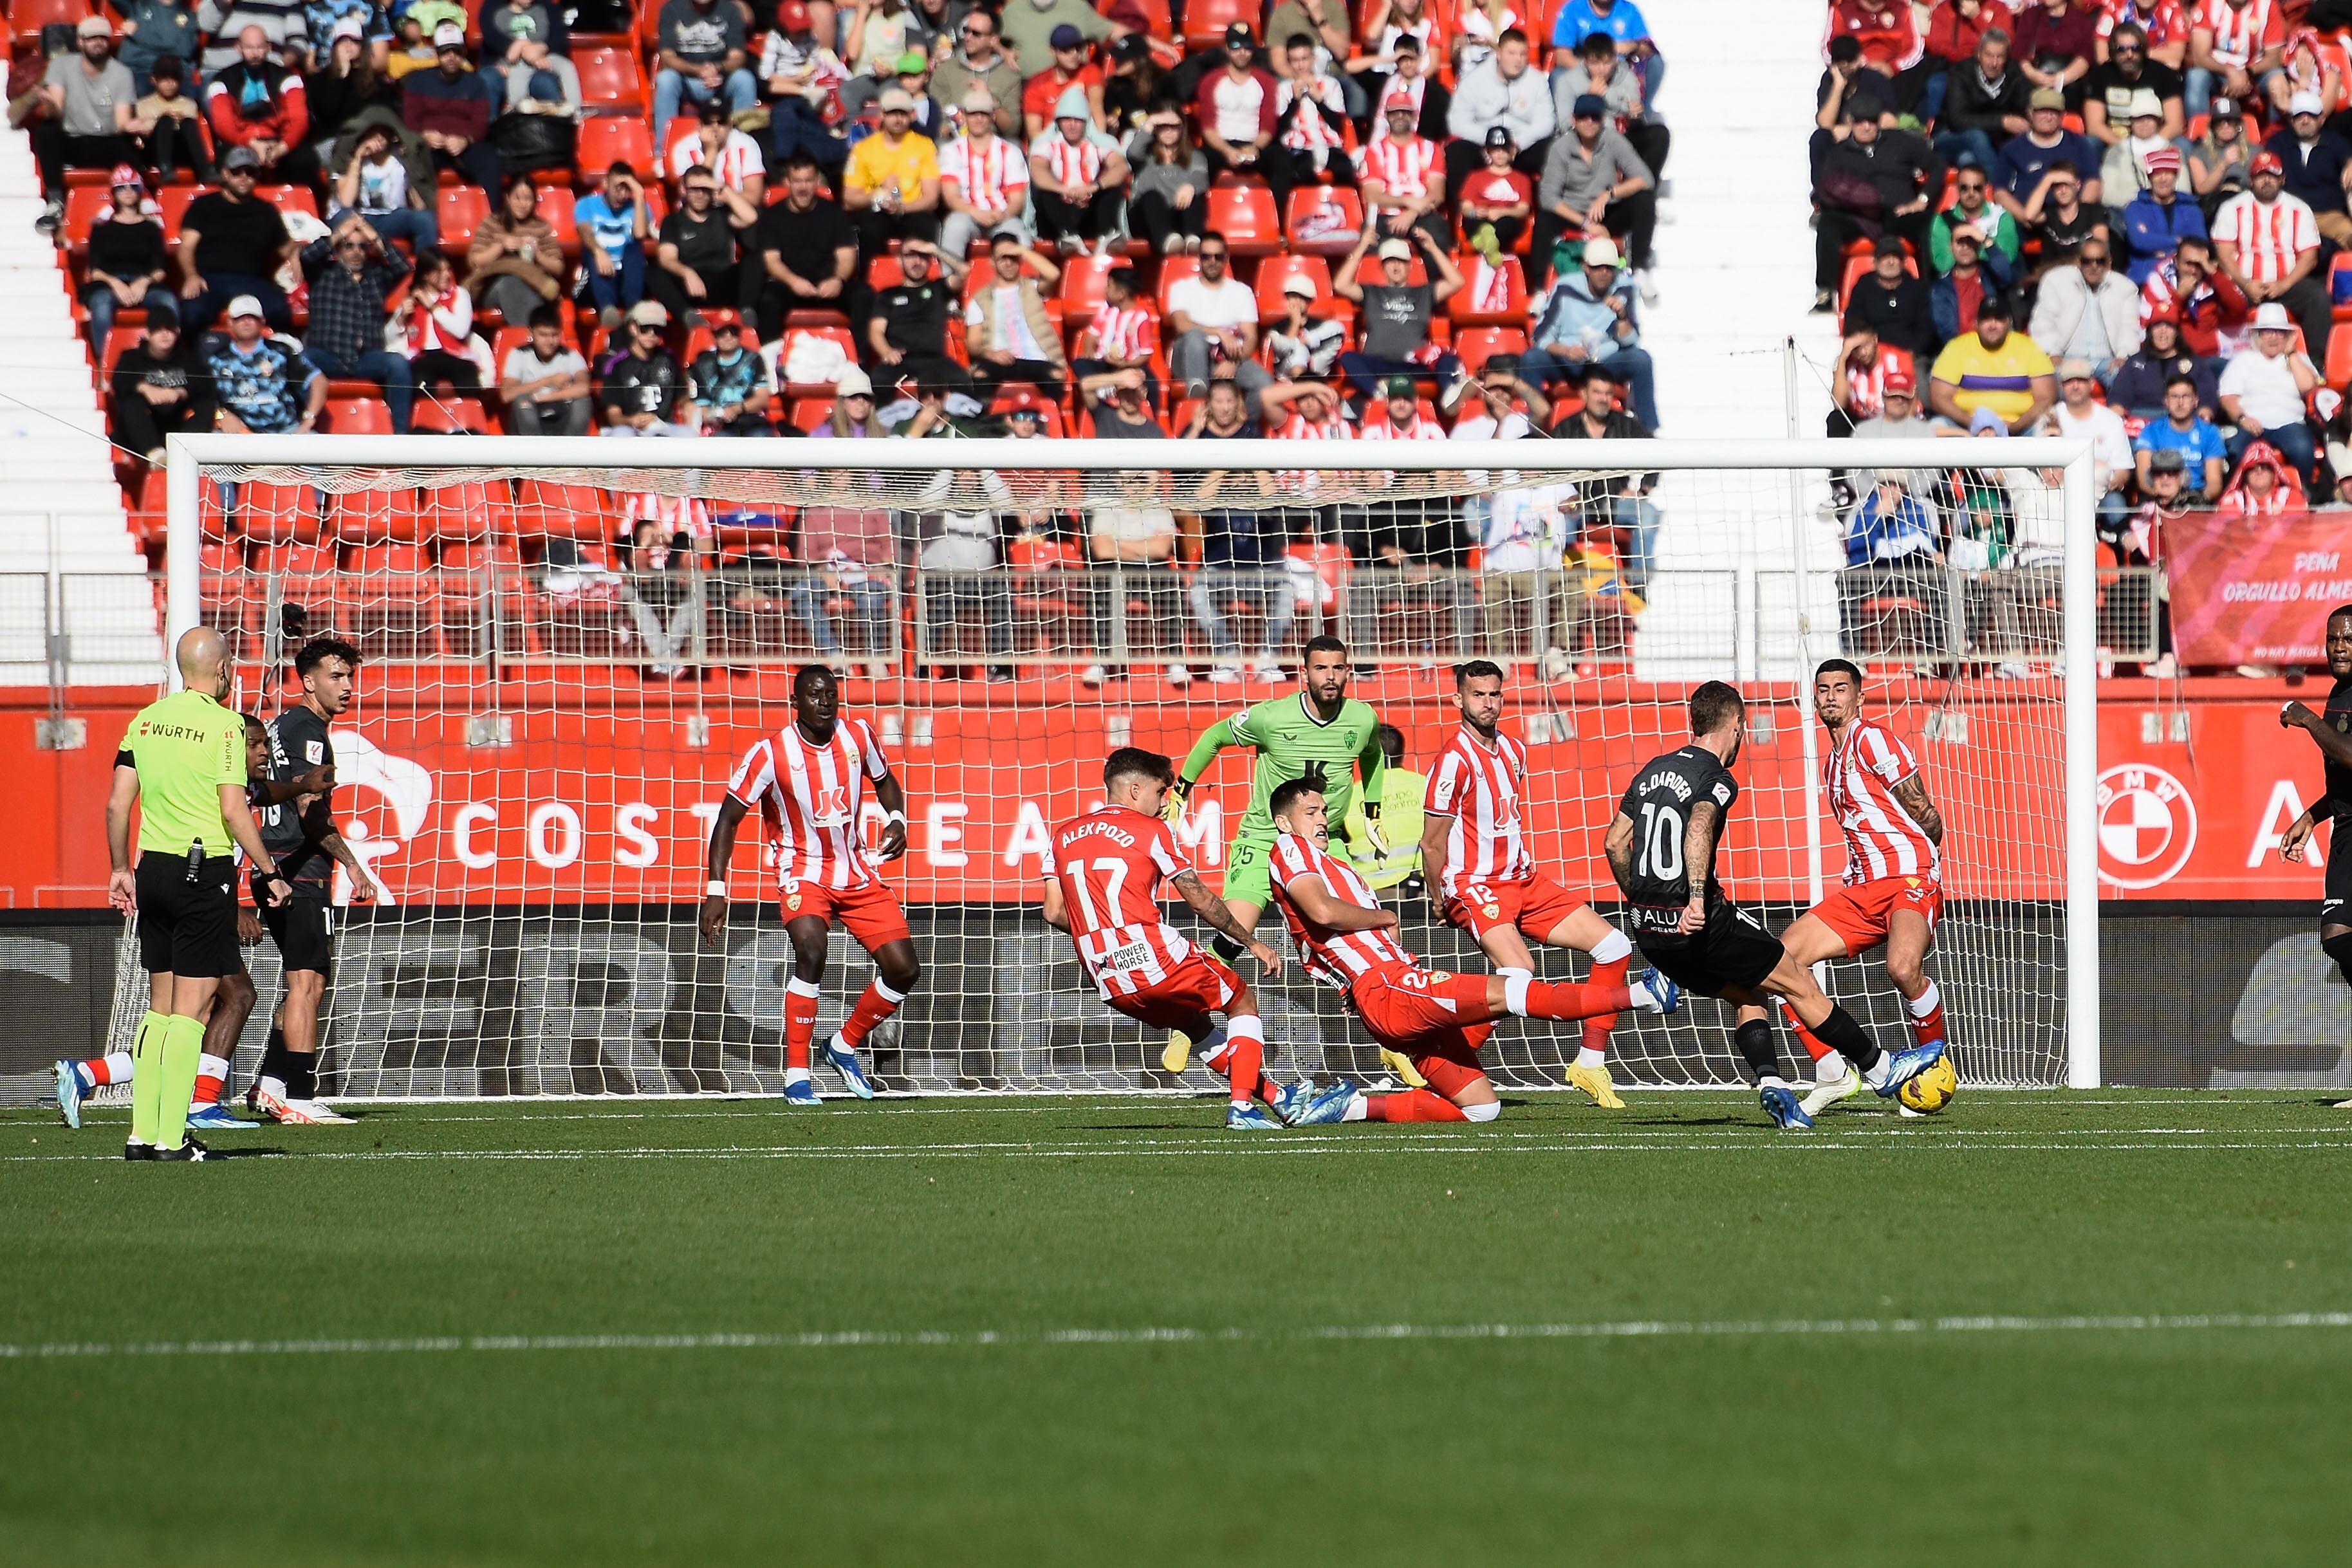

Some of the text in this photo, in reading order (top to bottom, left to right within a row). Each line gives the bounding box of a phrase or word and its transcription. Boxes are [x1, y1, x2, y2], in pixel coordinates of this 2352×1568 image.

[2224, 582, 2302, 602] ORGULLO
[2254, 646, 2267, 658] NO
[2270, 647, 2286, 658] HAY
[153, 723, 205, 742] WÜRTH
[1639, 771, 1692, 802] S.DARDER
[2097, 771, 2180, 806] BMW
[454, 802, 776, 869] COST
[1095, 821, 1136, 848] POZO
[2246, 780, 2334, 868] A
[1639, 802, 1683, 880] 10
[1066, 857, 1129, 932] 17
[1466, 885, 1499, 905] 12
[1644, 909, 1681, 925] ALU
[1114, 943, 1146, 960] POWER
[1116, 952, 1151, 972] HORSE
